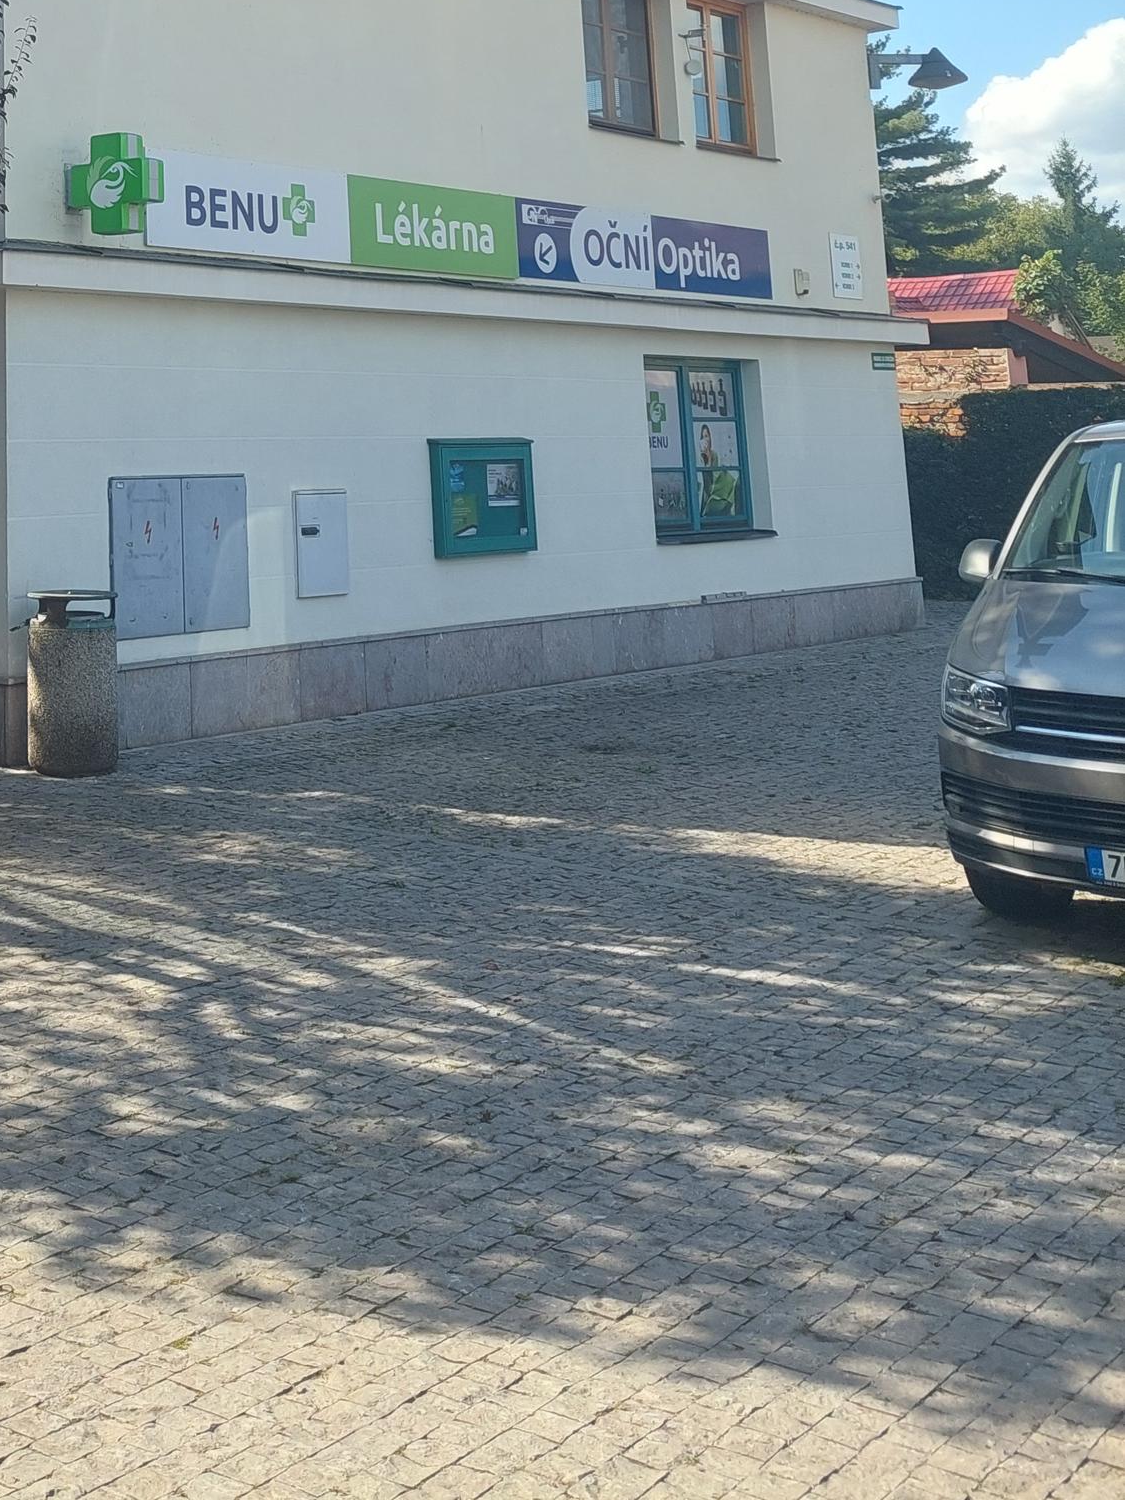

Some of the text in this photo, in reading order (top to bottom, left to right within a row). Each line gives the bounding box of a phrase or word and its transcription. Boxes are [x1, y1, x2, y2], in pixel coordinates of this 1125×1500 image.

[185, 184, 279, 234] BENU
[374, 200, 495, 255] Lékárna
[583, 219, 741, 288] OČNÍ Optika
[1091, 867, 1104, 876] CZ
[1107, 854, 1125, 878] 7
